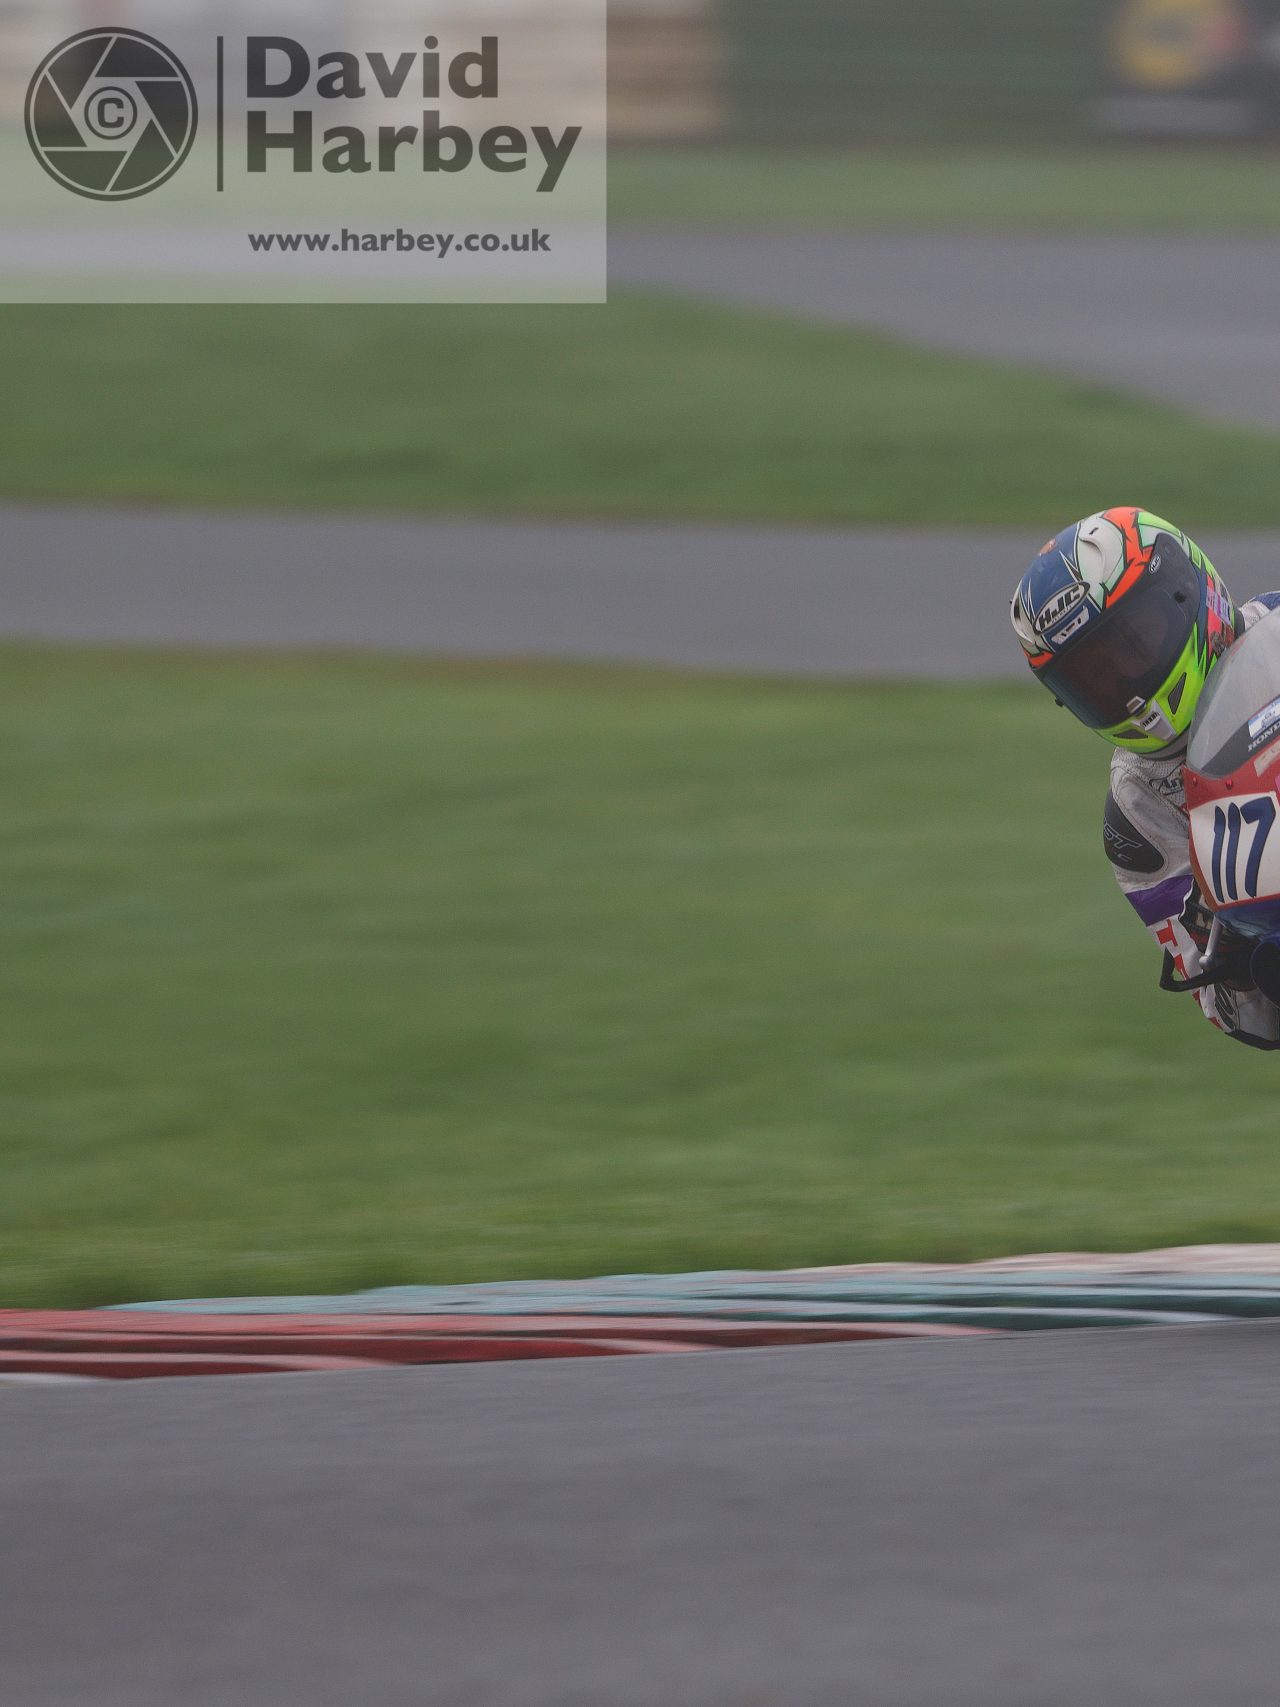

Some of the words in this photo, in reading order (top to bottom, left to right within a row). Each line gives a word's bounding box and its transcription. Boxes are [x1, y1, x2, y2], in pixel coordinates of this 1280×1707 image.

[1039, 584, 1080, 631] HJC
[1103, 817, 1144, 849] ST
[1211, 796, 1277, 903] 117
